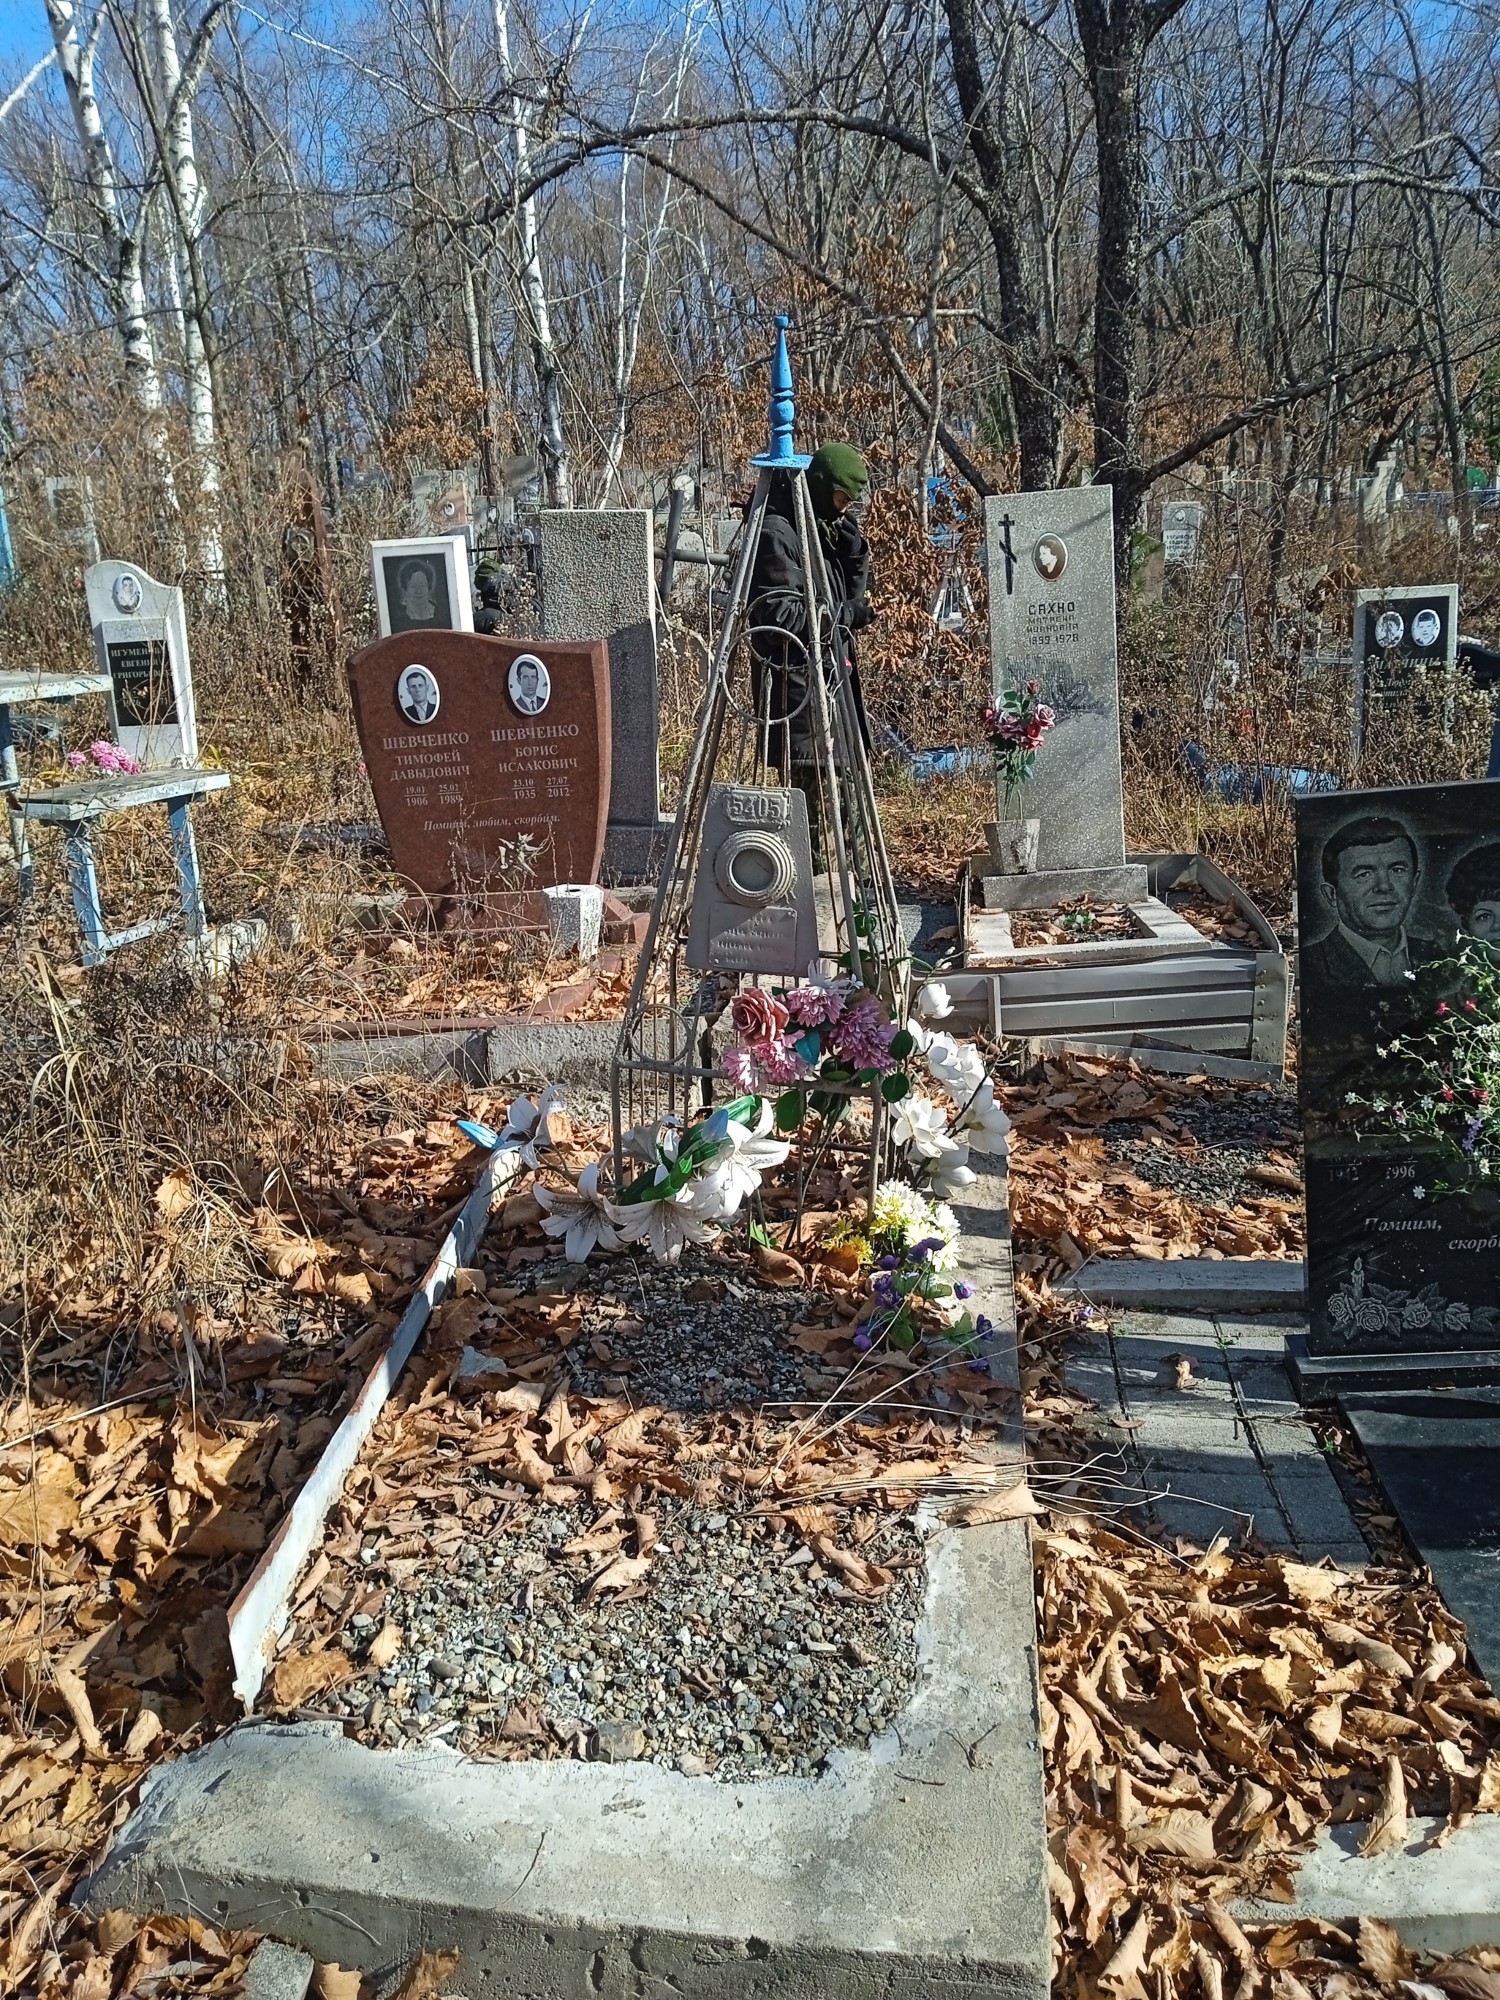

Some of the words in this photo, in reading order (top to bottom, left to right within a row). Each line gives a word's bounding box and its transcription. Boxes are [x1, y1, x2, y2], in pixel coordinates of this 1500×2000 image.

[1028, 601, 1076, 615] САХНО
[1054, 633, 1079, 644] 1978
[111, 647, 165, 657] ИГУМЕНВ
[490, 724, 580, 742] ШЕВЧЕНКО
[382, 731, 470, 750] ШЕВЧЕНКО
[395, 749, 461, 766] ТИМОФЕЙ
[515, 744, 559, 758] БОРИС
[498, 757, 578, 773] ИСААКОВИЧ
[390, 765, 471, 782] ДАВЫДОВИЧ
[405, 785, 426, 795] 19.01
[438, 783, 460, 793] 25.02
[513, 778, 534, 788] 23.10
[546, 776, 568, 786] 27.07
[406, 796, 429, 807] 1906
[439, 794, 462, 805] 1989
[514, 789, 536, 800] 1935
[547, 787, 570, 798] 2012
[472, 816, 512, 829] любим,
[1385, 1164, 1416, 1180] 1996
[1364, 1216, 1443, 1233] Помним,
